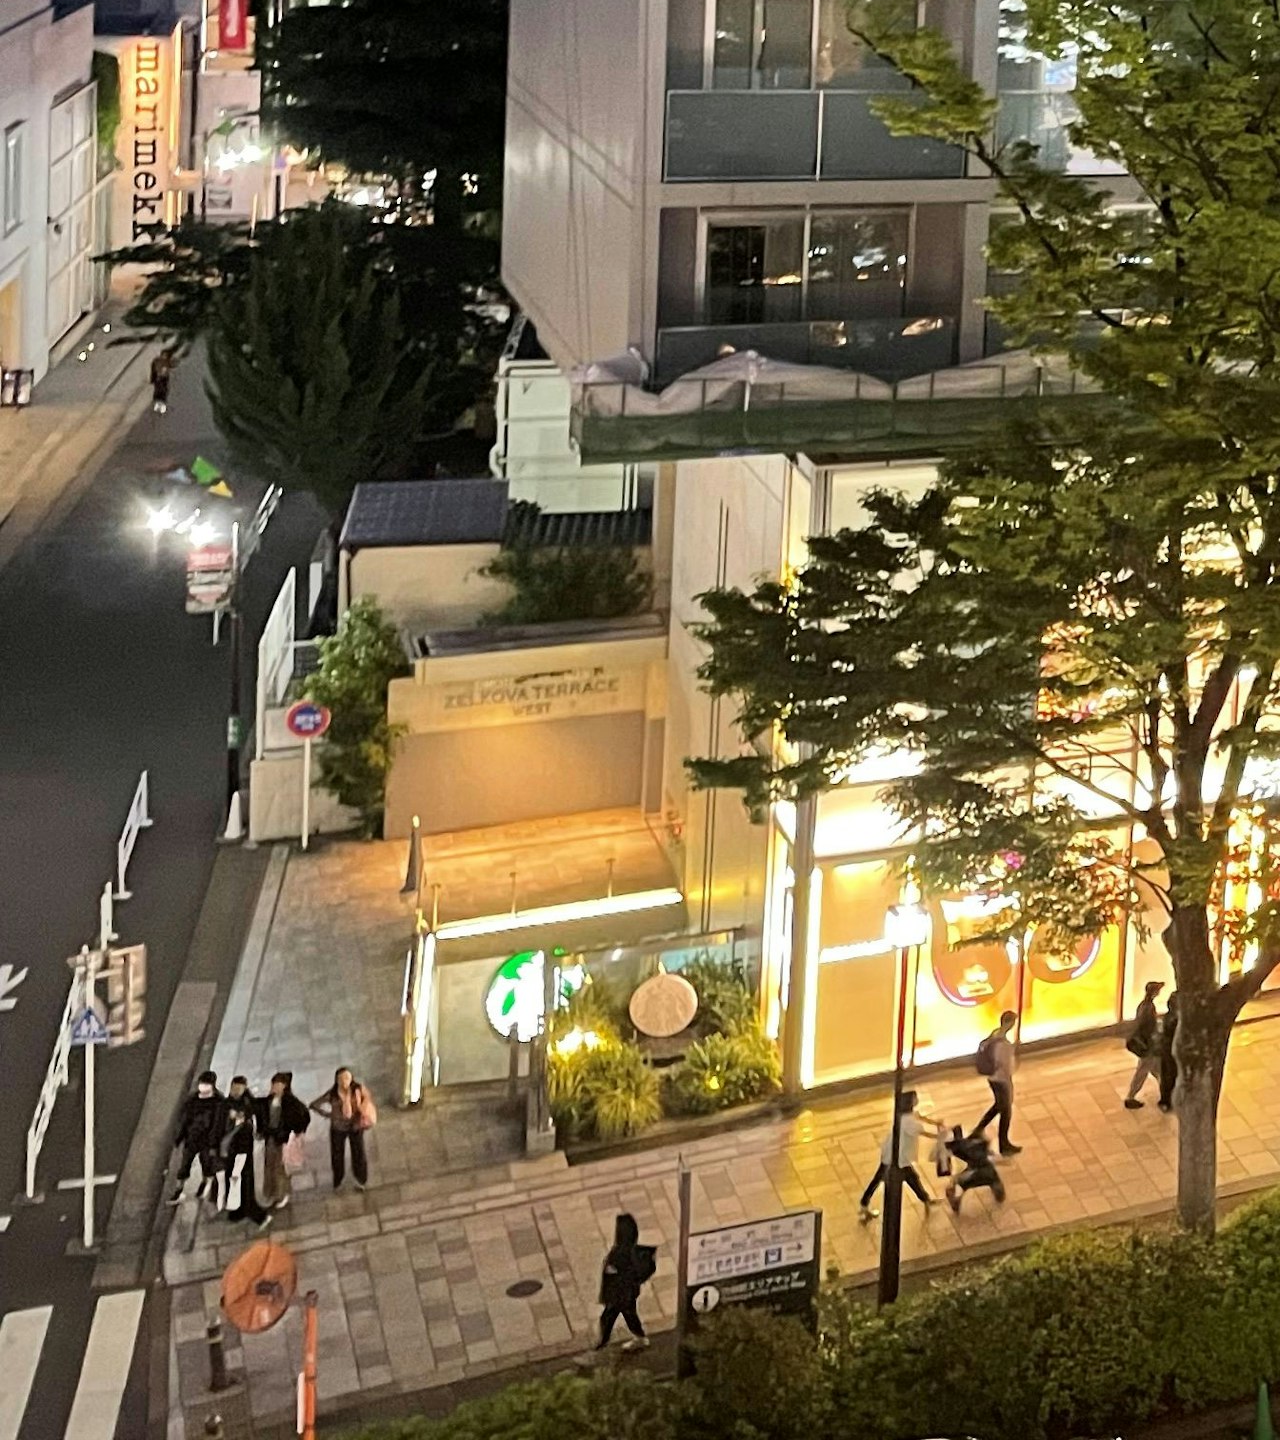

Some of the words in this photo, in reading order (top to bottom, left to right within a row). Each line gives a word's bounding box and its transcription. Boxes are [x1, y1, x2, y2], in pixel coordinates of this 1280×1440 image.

[445, 686, 530, 710] ZELKOVA
[536, 679, 619, 700] TERRACE
[512, 702, 550, 717] WEST
